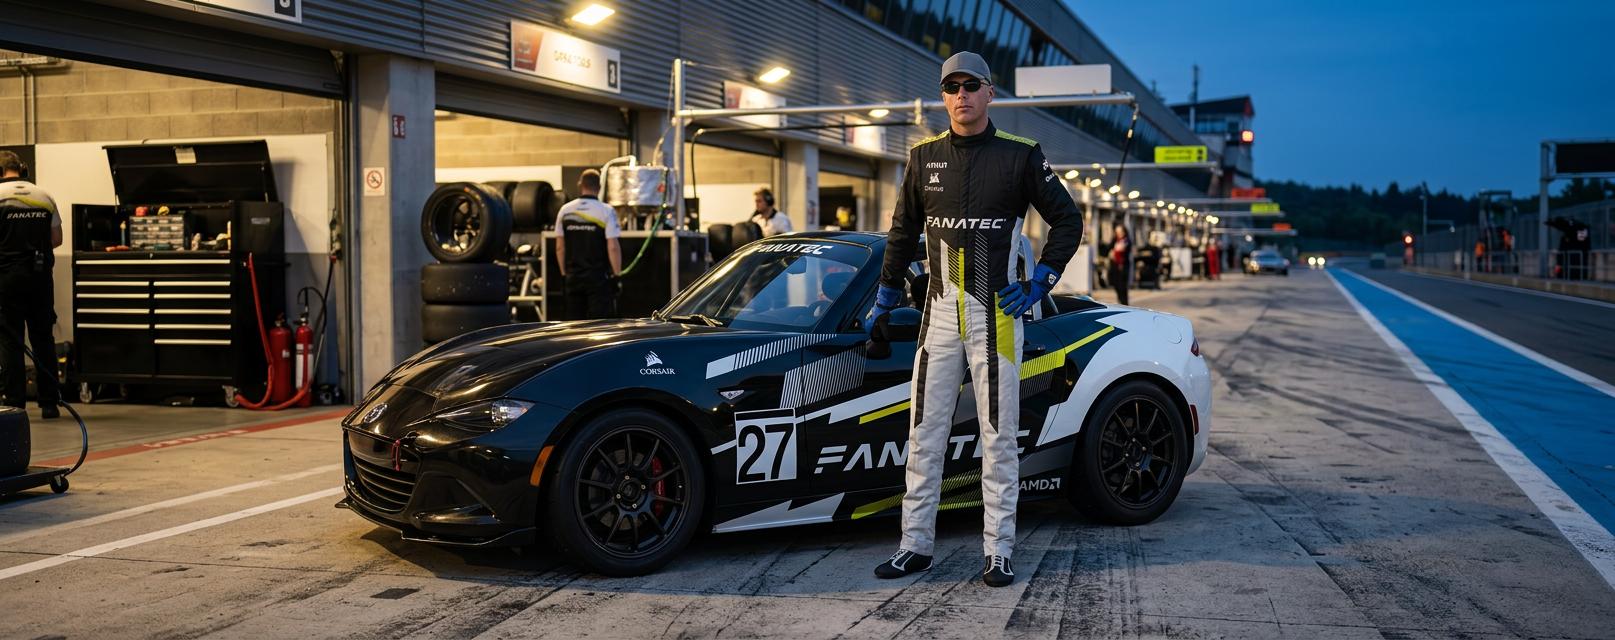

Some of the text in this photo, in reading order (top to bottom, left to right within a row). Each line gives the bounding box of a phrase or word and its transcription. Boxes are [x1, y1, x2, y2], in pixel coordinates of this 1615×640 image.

[926, 215, 1003, 230] FANATEC
[738, 422, 795, 483] 27
[814, 429, 1030, 475] FANT
[1019, 479, 1050, 491] AMD
